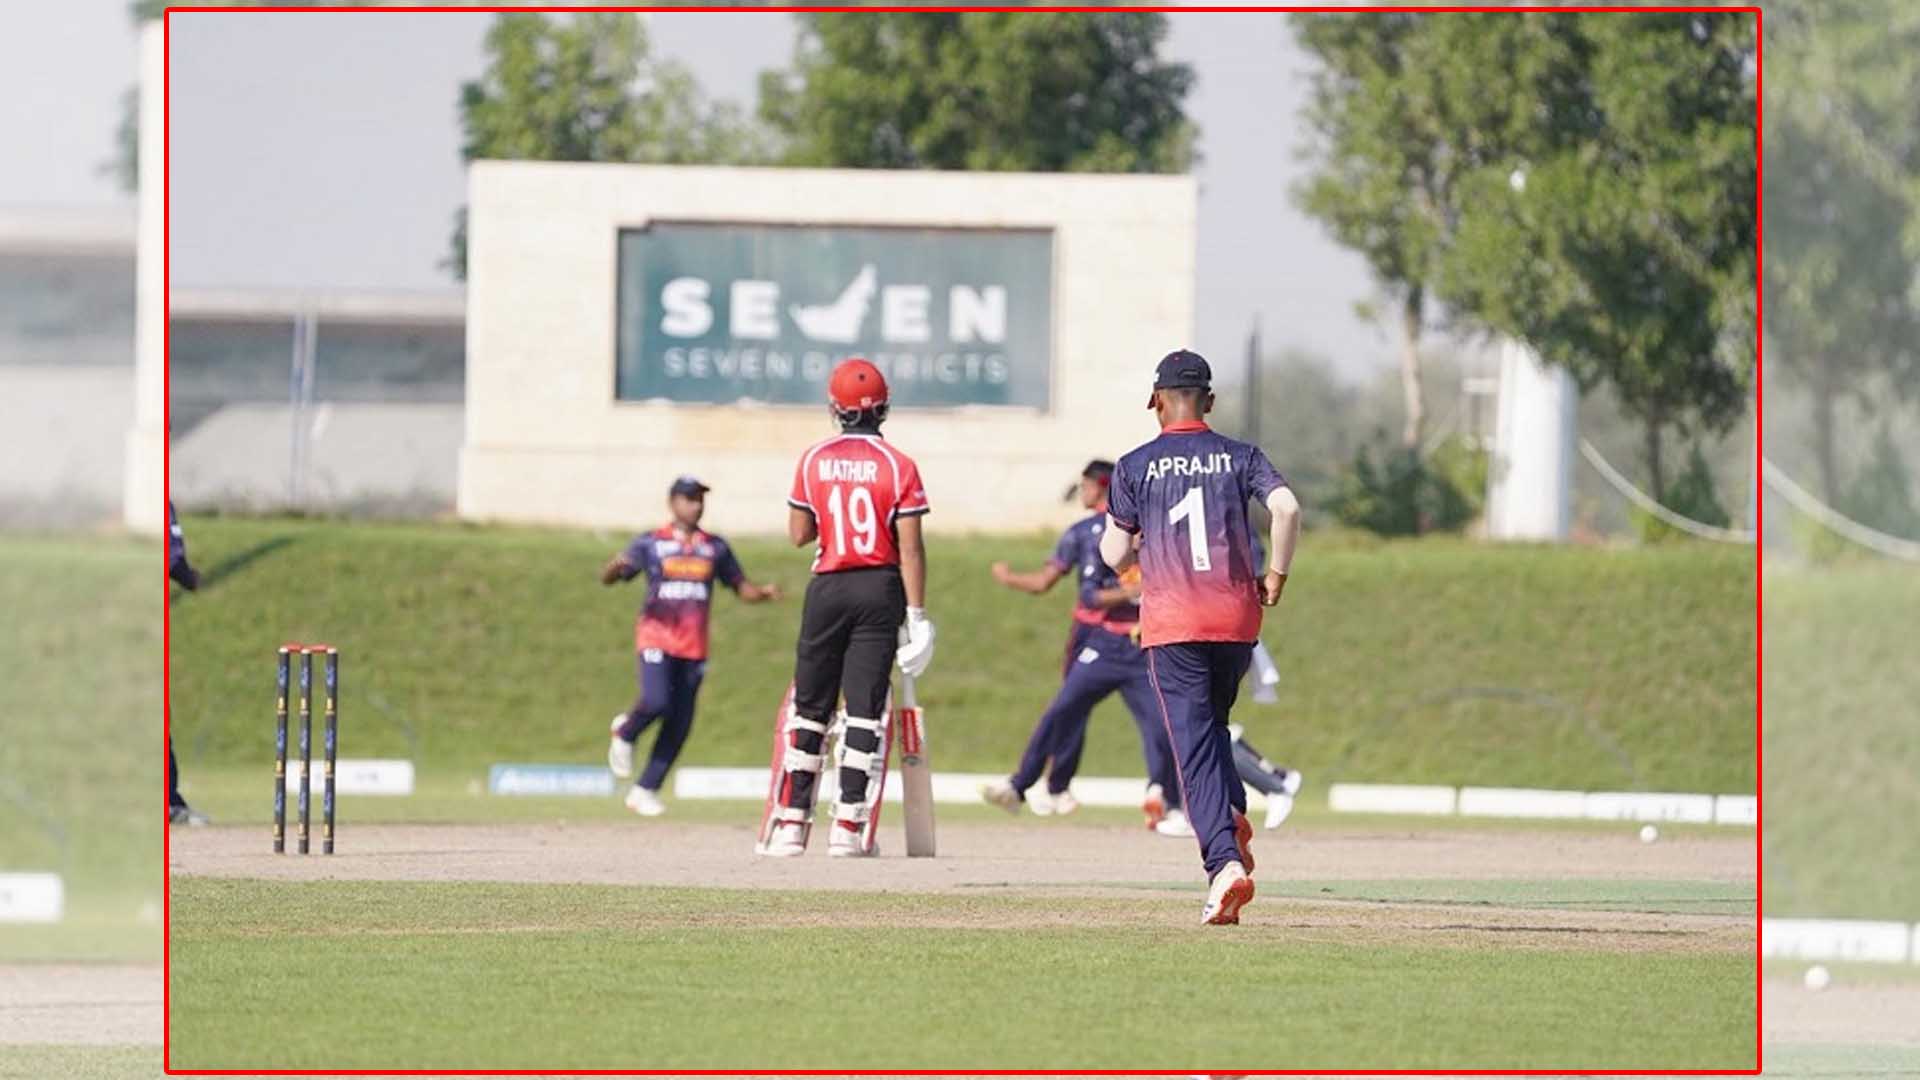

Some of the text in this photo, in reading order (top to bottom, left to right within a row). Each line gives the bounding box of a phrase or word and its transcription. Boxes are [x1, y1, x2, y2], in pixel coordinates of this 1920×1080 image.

[664, 347, 1009, 383] SEVEN DTRICTS
[818, 459, 879, 482] MATHUR
[1145, 453, 1232, 481] APRAJIT
[828, 484, 877, 556] 19
[1168, 486, 1212, 571] 1
